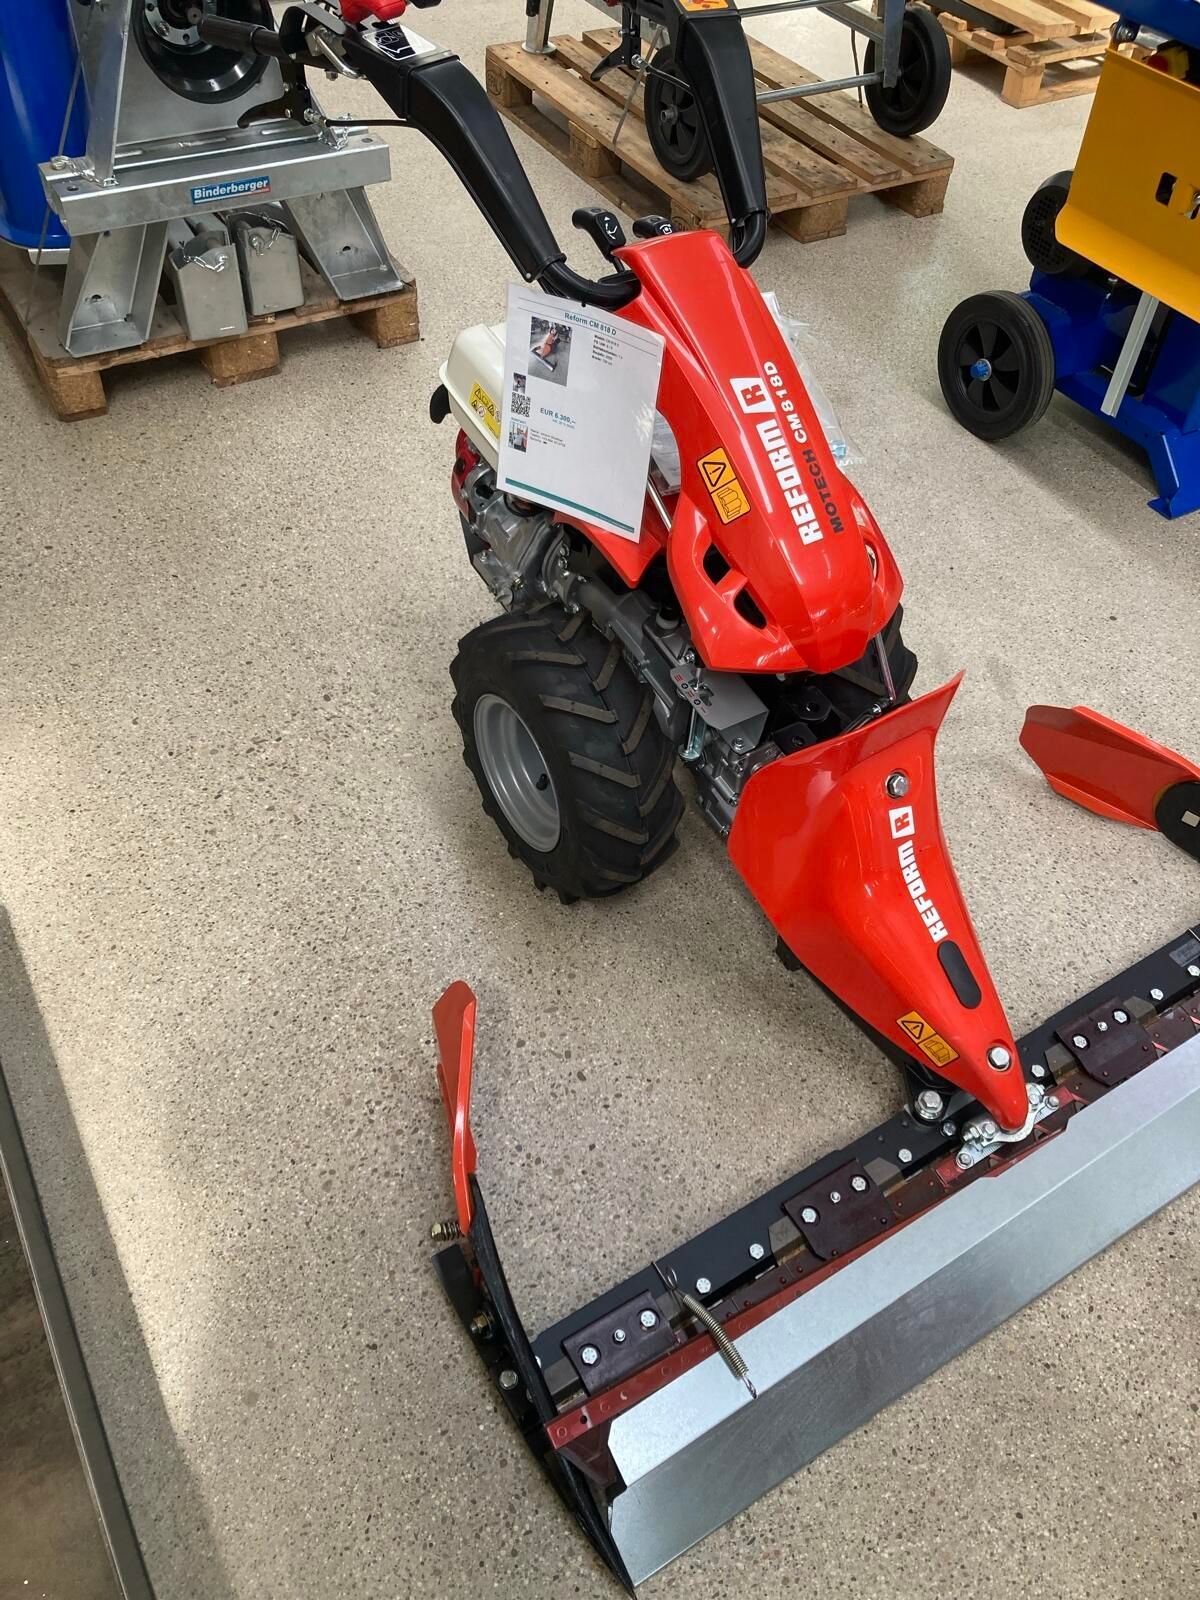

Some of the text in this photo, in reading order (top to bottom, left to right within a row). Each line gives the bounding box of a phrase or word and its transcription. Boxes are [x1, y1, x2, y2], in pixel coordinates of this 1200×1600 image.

[194, 179, 268, 199] Binderberger
[564, 312, 617, 336] Reform CM 818 D
[540, 407, 554, 417] EUR
[756, 418, 824, 546] REFORM
[802, 448, 844, 534] MOTECH
[897, 839, 949, 944] REFORM
